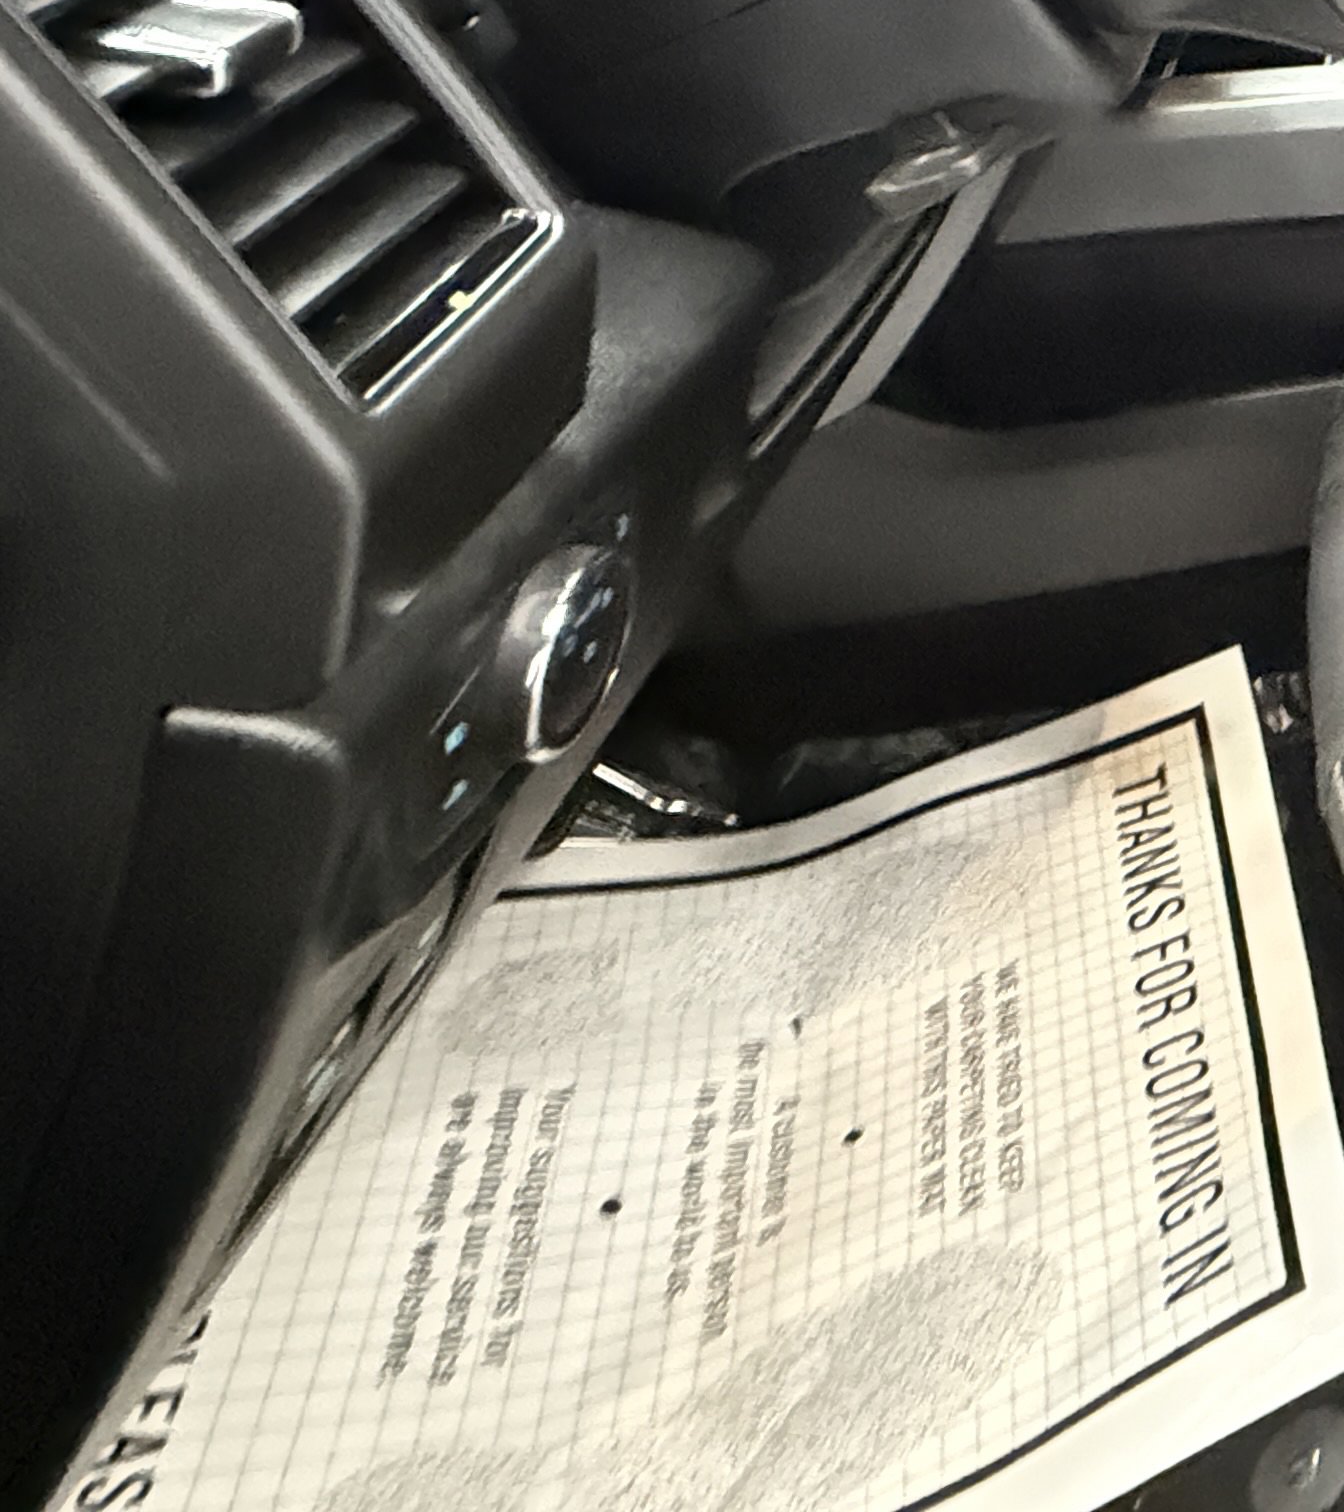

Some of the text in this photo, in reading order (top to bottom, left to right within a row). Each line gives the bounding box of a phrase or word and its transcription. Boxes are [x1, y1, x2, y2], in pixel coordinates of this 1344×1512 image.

[960, 971, 985, 1031] YOUR
[1112, 762, 1234, 1310] THANKS FOR COMING IN
[997, 1043, 1022, 1108] TRIED
[920, 1094, 947, 1169] PAPER
[997, 1103, 1024, 1137] TO
[414, 1138, 472, 1233] always
[714, 1139, 754, 1257] important
[761, 1114, 796, 1219] customer
[959, 1138, 986, 1216] CLEAN
[999, 1136, 1024, 1193] KEEP
[457, 1222, 492, 1271] our
[481, 1083, 578, 1367] Your suggestions for
[429, 1274, 478, 1386] service
